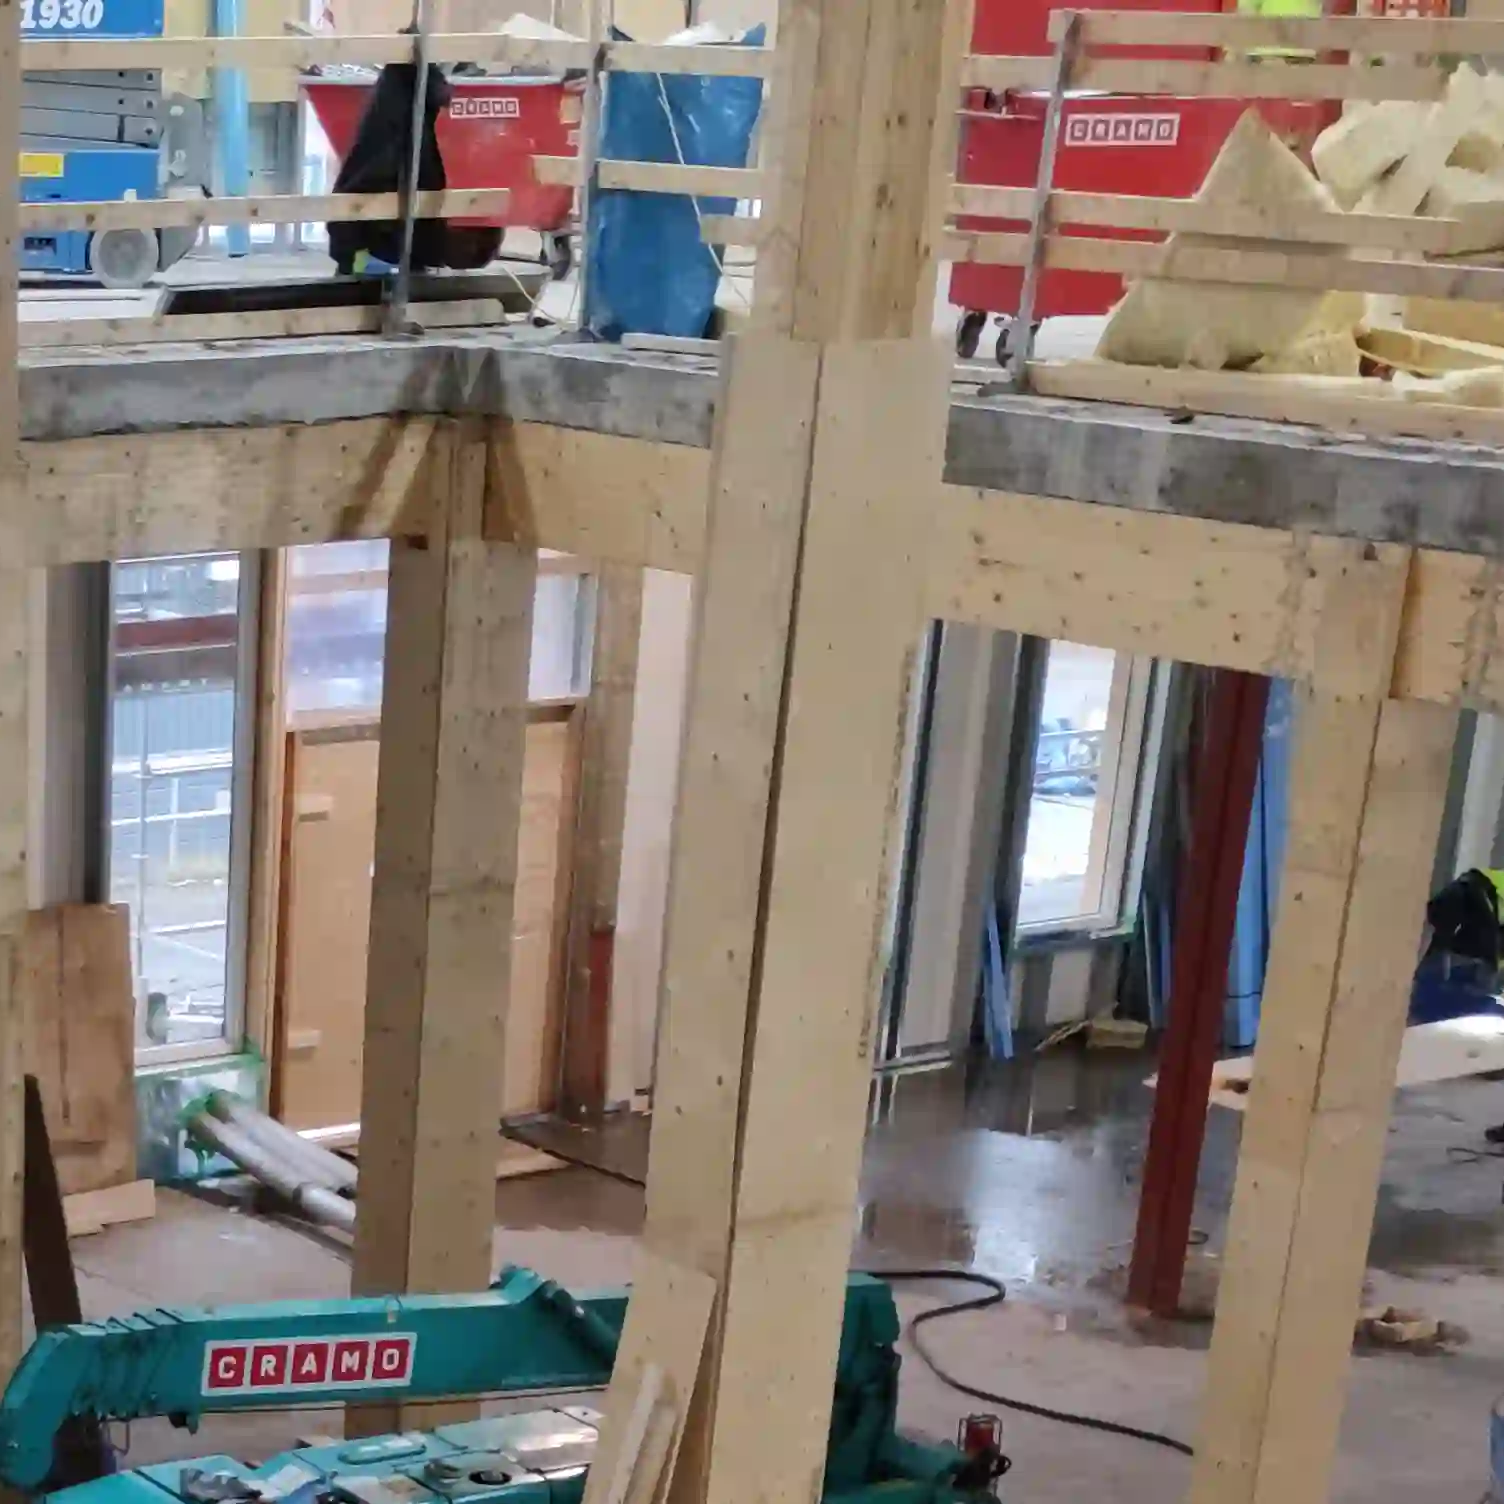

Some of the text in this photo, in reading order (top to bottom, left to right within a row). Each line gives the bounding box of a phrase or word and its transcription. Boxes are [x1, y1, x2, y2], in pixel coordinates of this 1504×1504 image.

[19, 0, 104, 29] 1930
[1071, 120, 1174, 139] CRAMO
[214, 1344, 404, 1383] CRAMO
